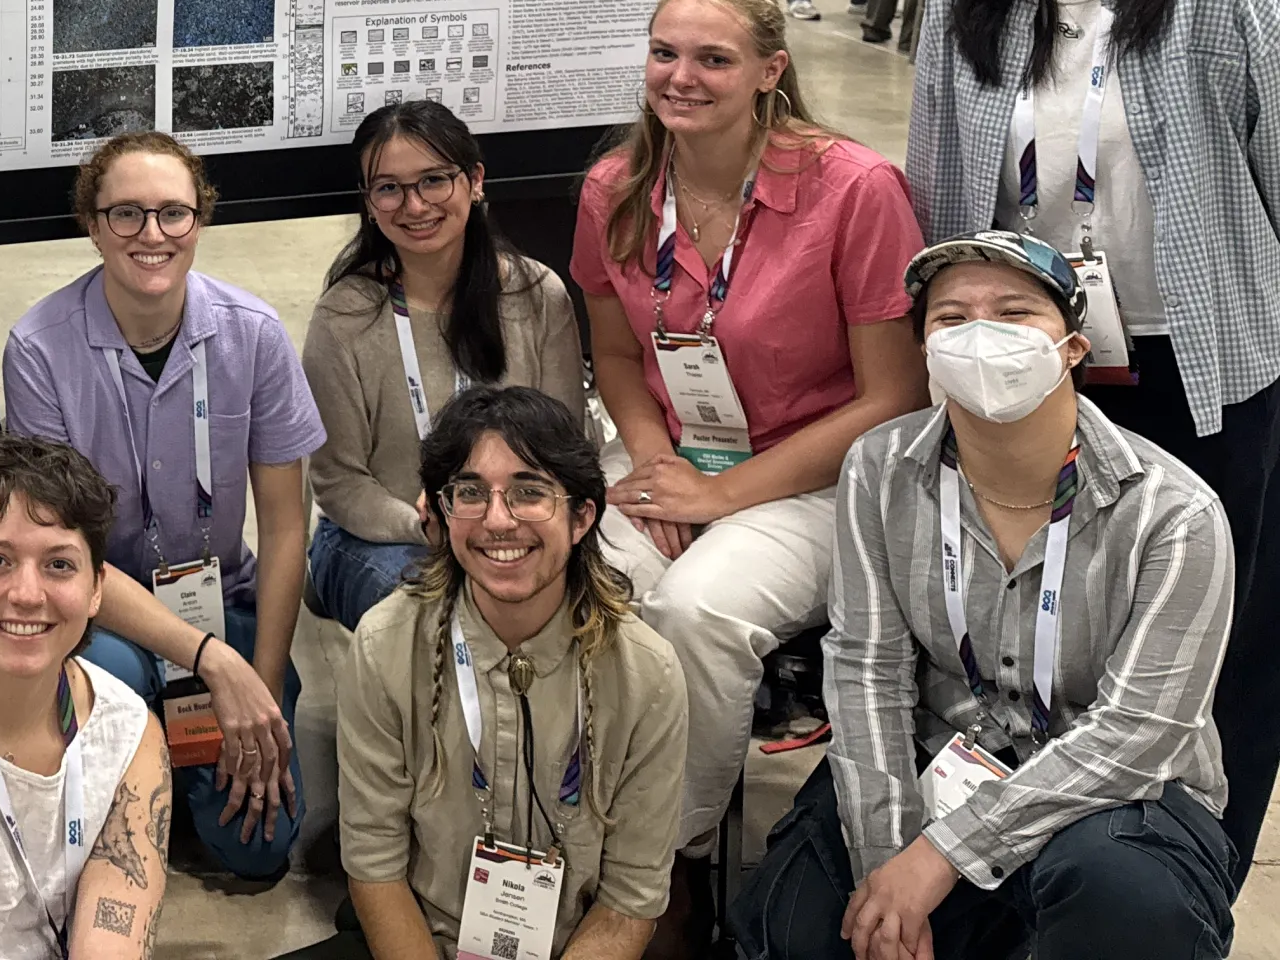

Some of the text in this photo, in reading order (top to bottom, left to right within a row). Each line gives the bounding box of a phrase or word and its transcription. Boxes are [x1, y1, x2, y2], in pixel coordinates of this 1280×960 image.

[365, 12, 467, 27] Explanation of Symbols
[505, 62, 551, 71] References
[180, 590, 197, 600] Claire
[502, 879, 525, 892] Nikola
